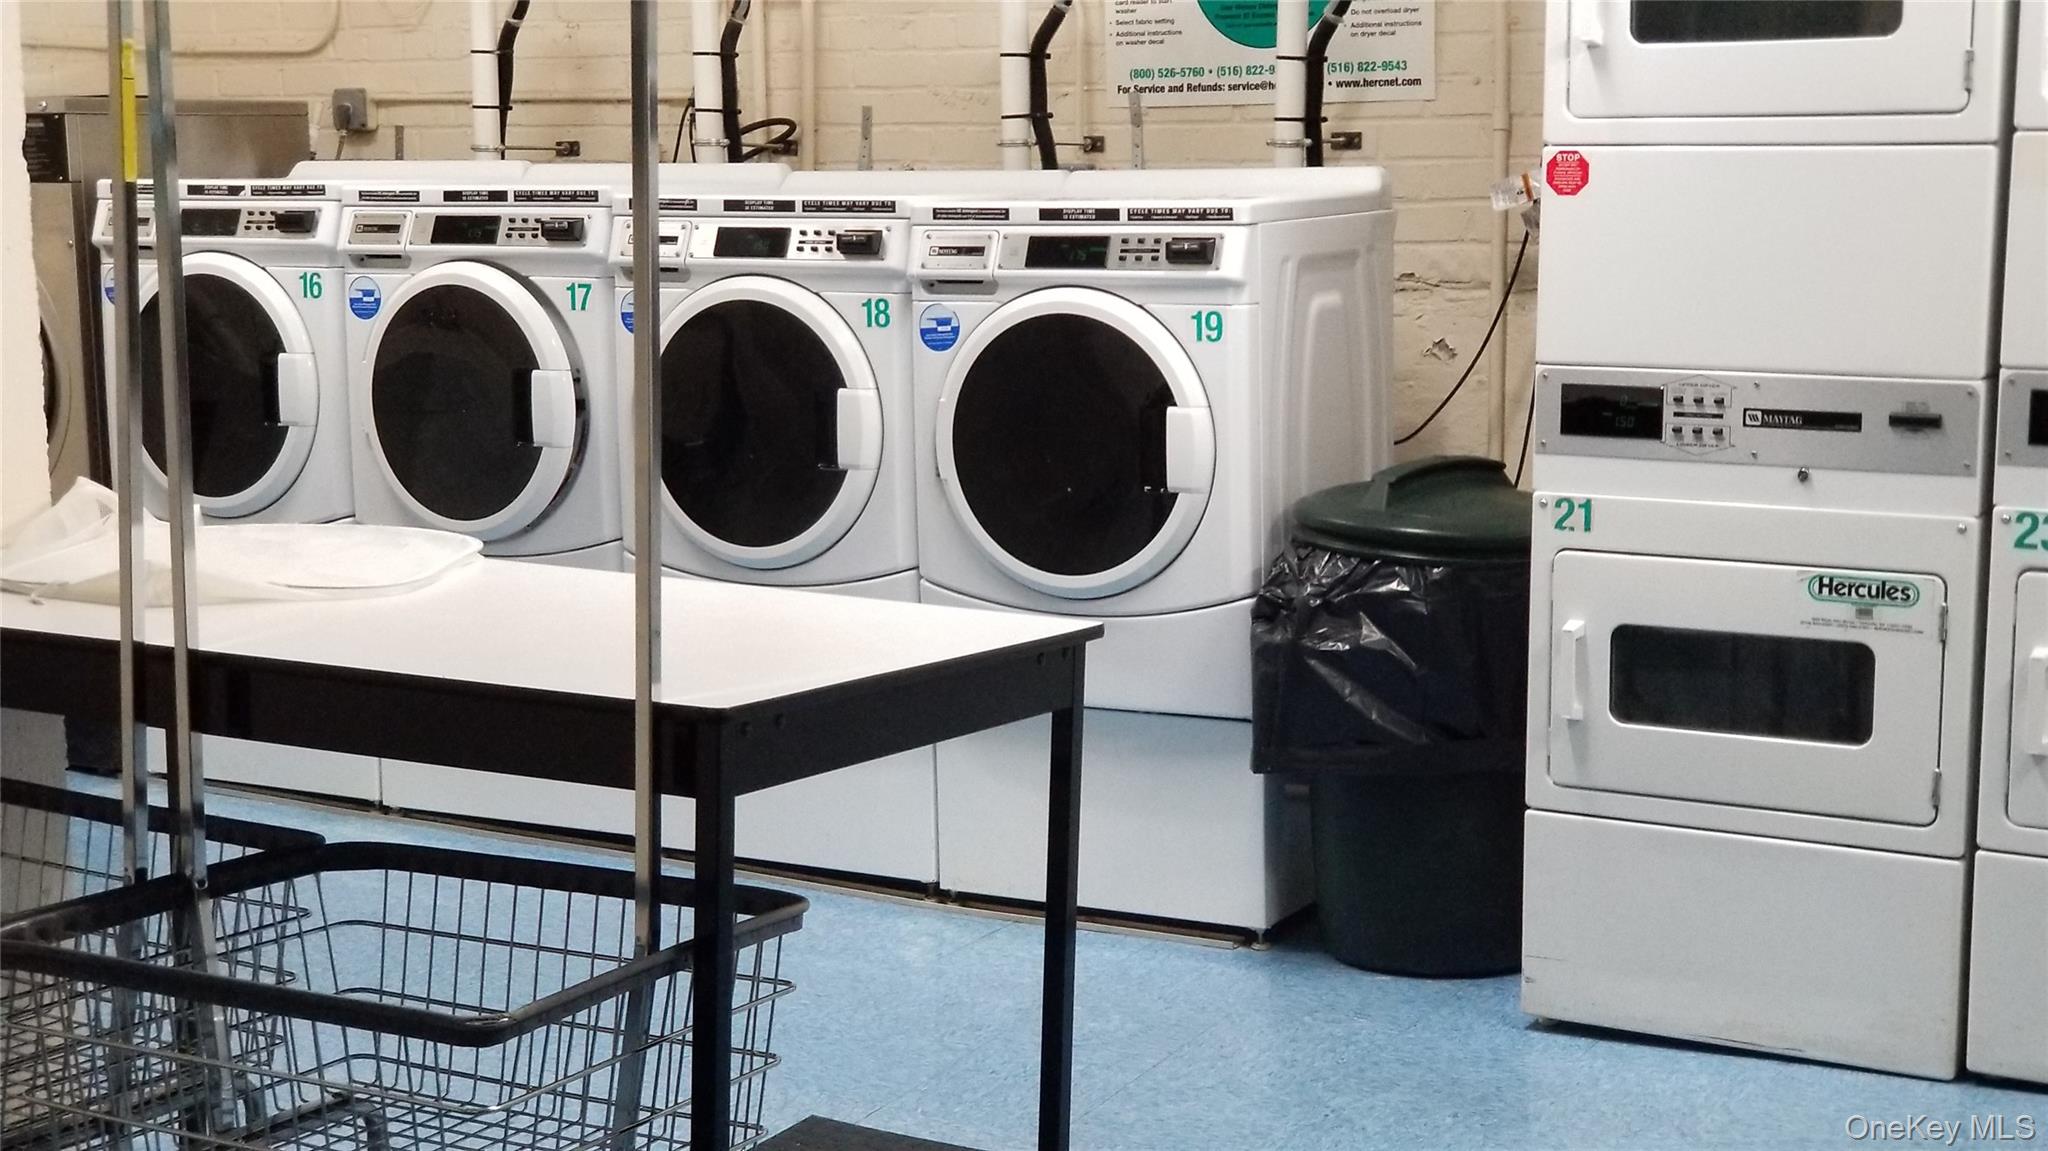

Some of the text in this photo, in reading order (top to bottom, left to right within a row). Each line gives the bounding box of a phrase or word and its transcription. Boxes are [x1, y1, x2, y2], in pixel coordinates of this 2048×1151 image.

[1373, 7, 1402, 15] overload
[1403, 7, 1420, 15] dryer
[1154, 18, 1175, 26] setting
[1147, 29, 1183, 37] instructions
[1148, 38, 1165, 46] decal
[1360, 31, 1377, 39] dryer
[1129, 60, 1408, 81] (800) 526-5760 (516) 822-9 (516) 822-9543
[1117, 84, 1132, 95] For
[1133, 83, 1166, 94] Service
[1167, 82, 1184, 93] and
[1186, 81, 1226, 93] Refunds:
[1335, 76, 1422, 89] www.hercnet.com
[1556, 153, 1581, 162] STOP
[299, 272, 323, 299] 16
[565, 282, 592, 312] 17
[861, 298, 891, 328] 18
[1190, 310, 1223, 343] 19
[1762, 413, 1802, 425] MAYTAG
[1554, 497, 1592, 533] 21
[1818, 575, 1912, 602] Hercules
